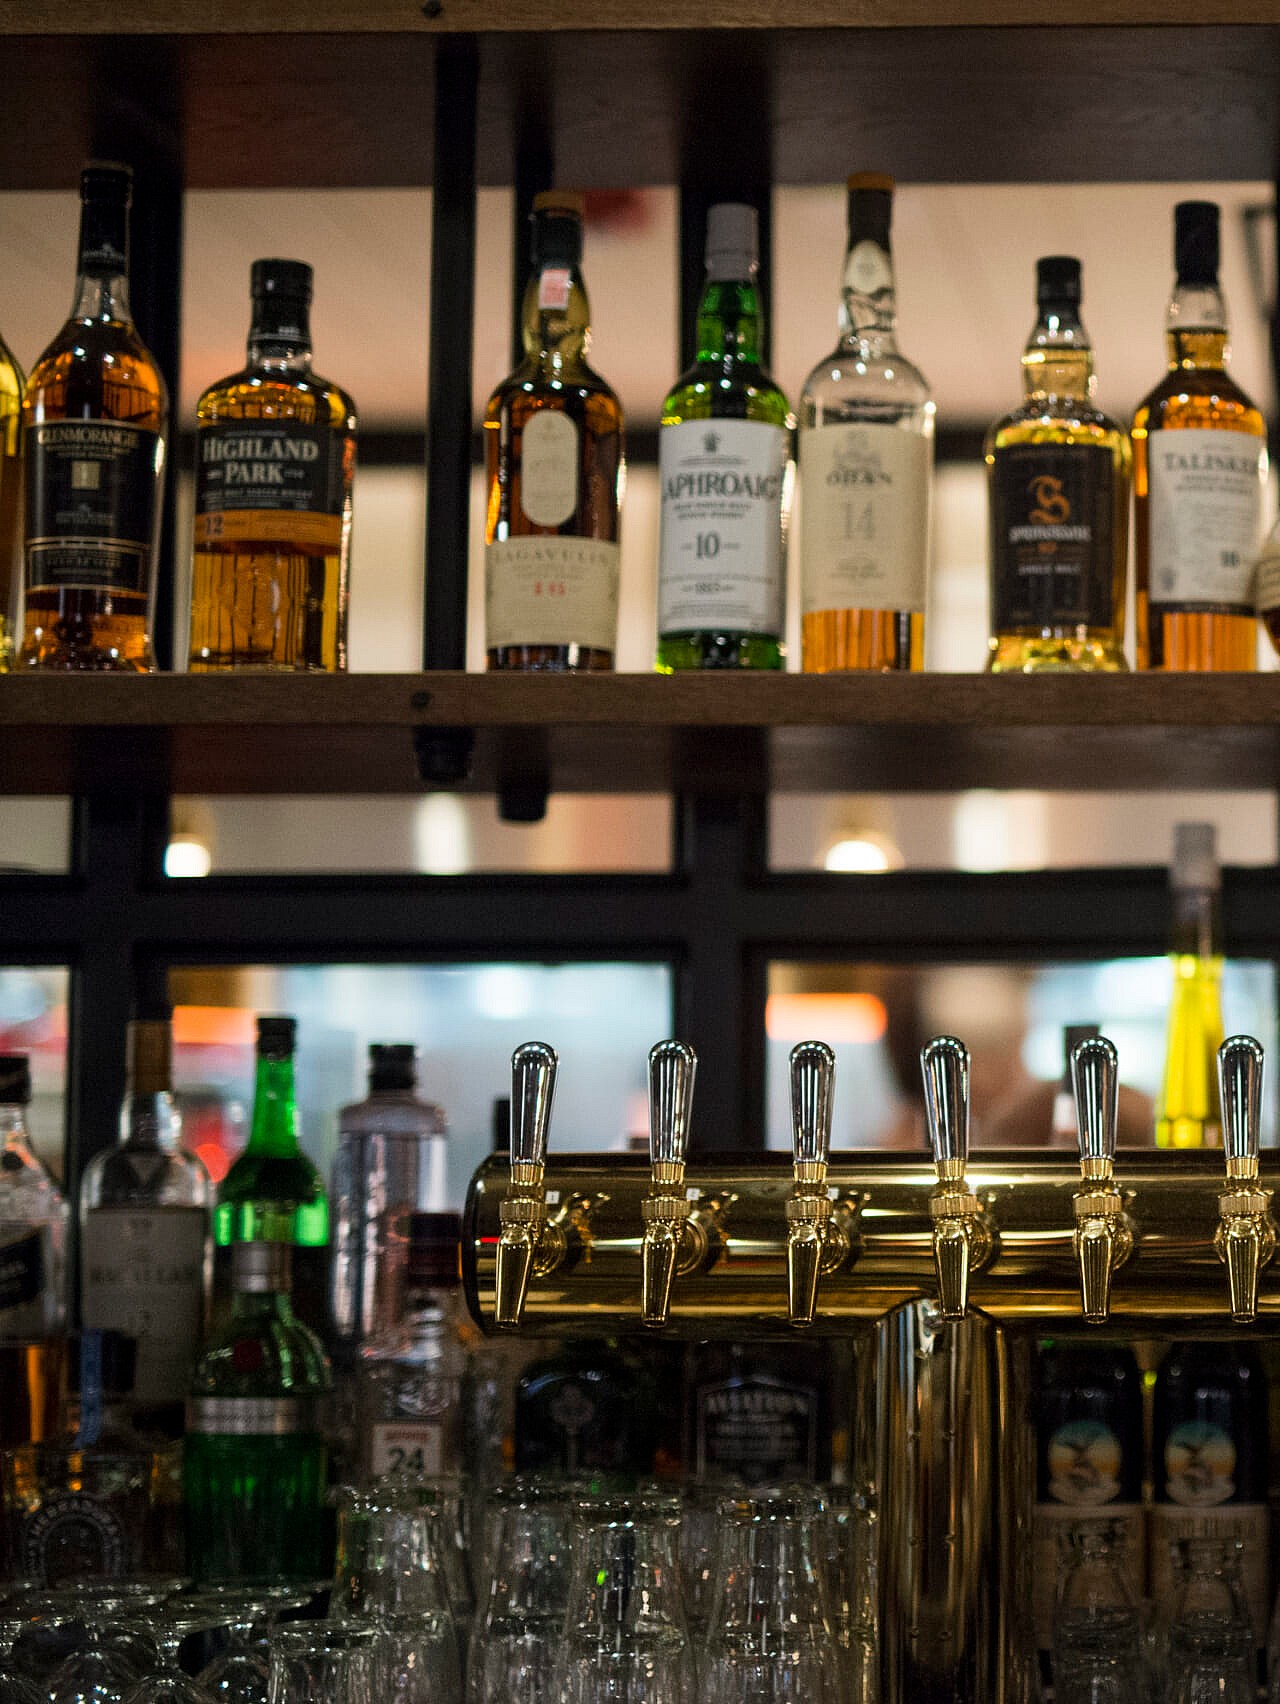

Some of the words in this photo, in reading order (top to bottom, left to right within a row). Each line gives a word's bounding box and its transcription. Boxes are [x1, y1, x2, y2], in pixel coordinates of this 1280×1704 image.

[203, 436, 319, 462] HIGHLAND
[225, 462, 284, 484] PARK
[695, 531, 721, 559] 10
[388, 1445, 425, 1475] 24
